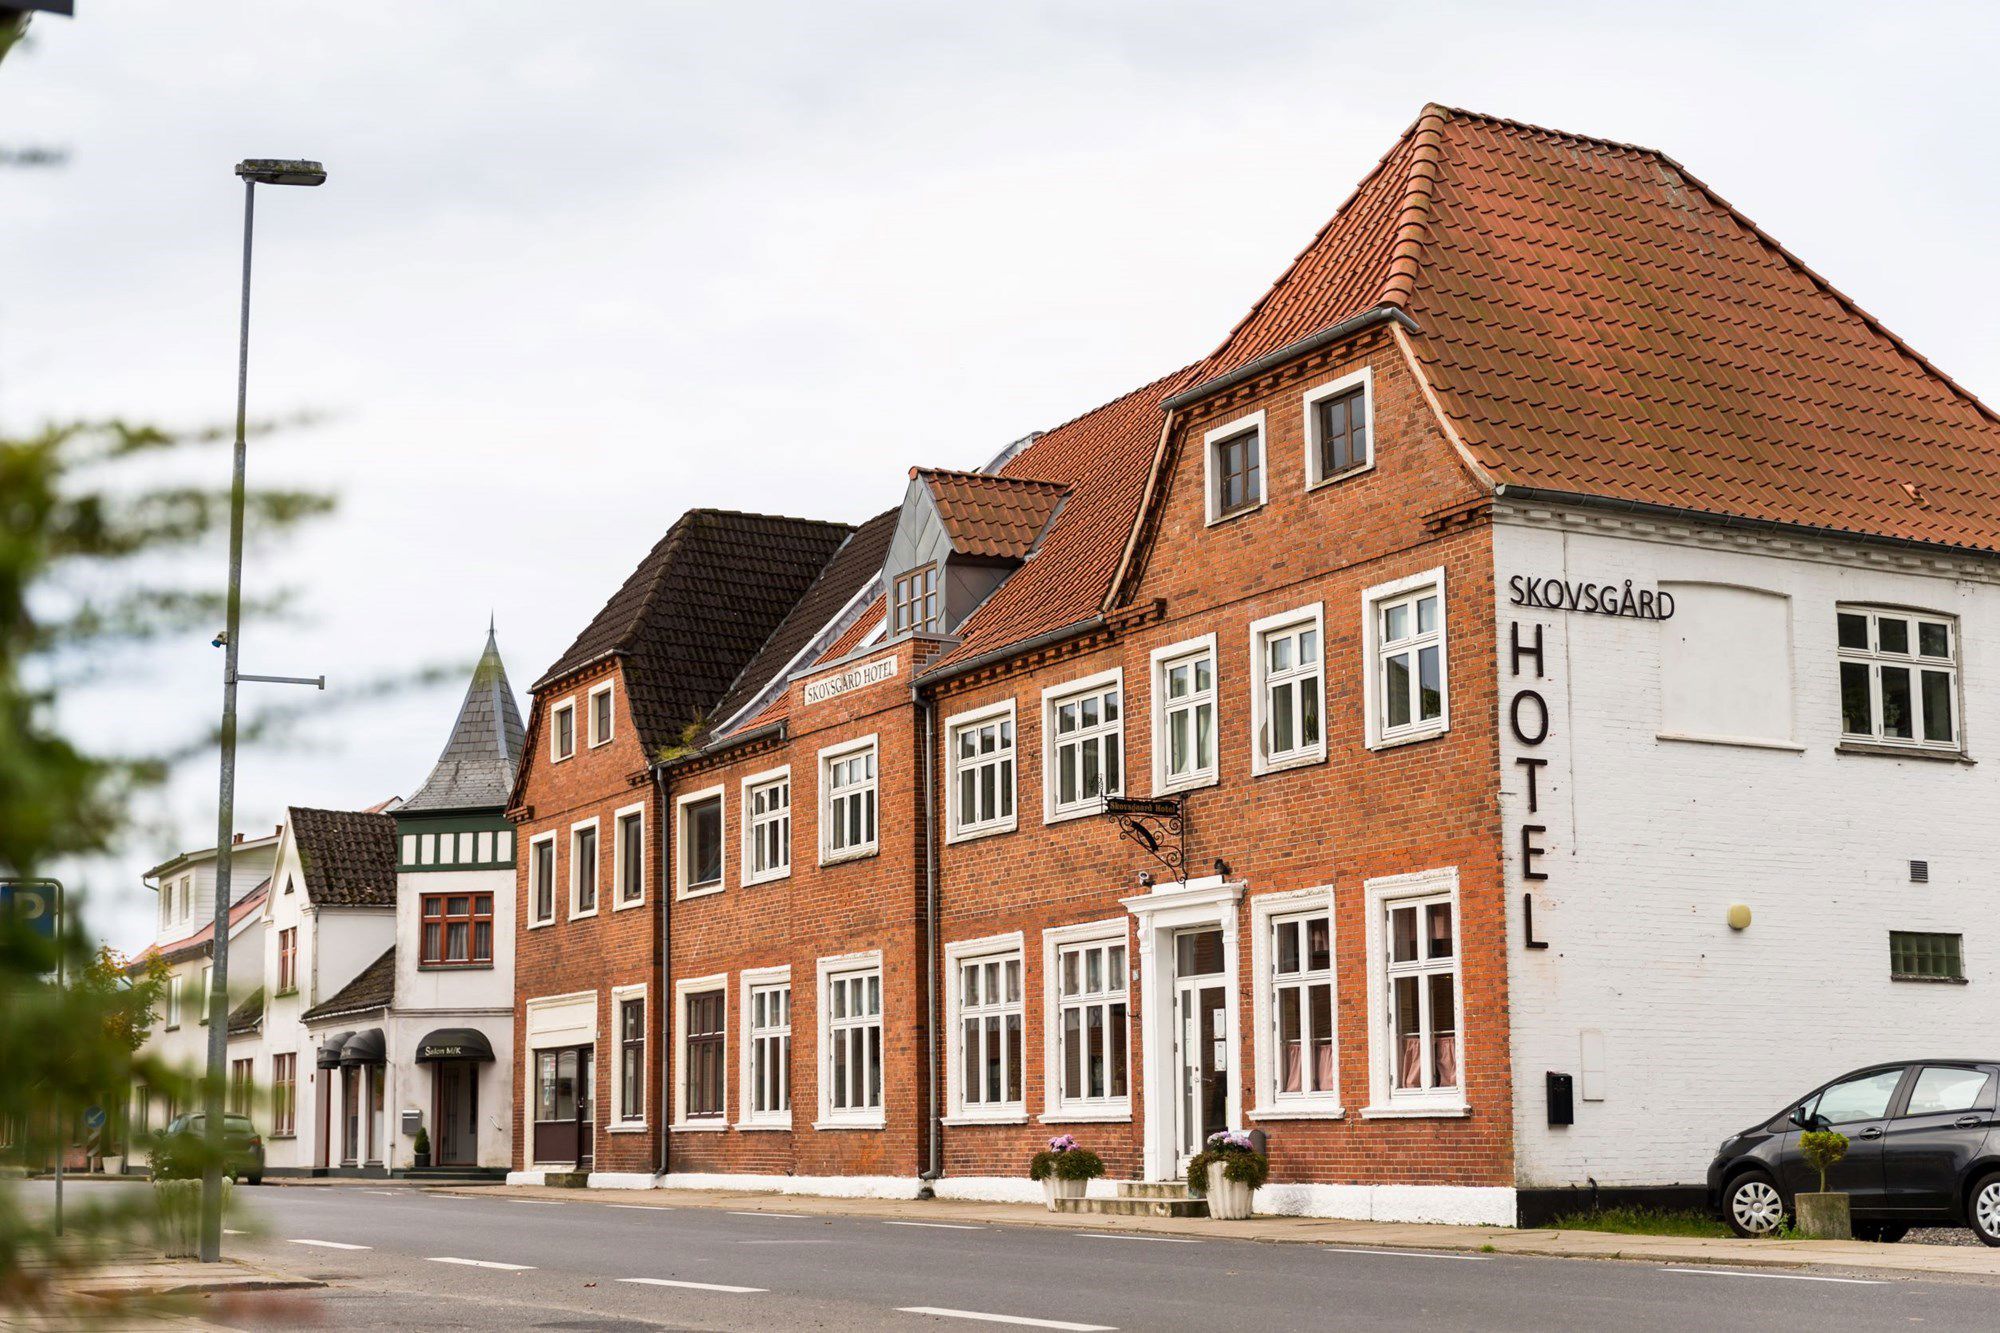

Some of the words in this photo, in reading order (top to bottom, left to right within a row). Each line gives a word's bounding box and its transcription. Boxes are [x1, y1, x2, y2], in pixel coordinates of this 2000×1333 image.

[1510, 575, 1675, 620] SKOVSGÅRD
[863, 660, 894, 684] HOTEL
[1511, 621, 1549, 949] HOTEL
[1155, 803, 1176, 813] Hotel
[13, 892, 45, 926] P
